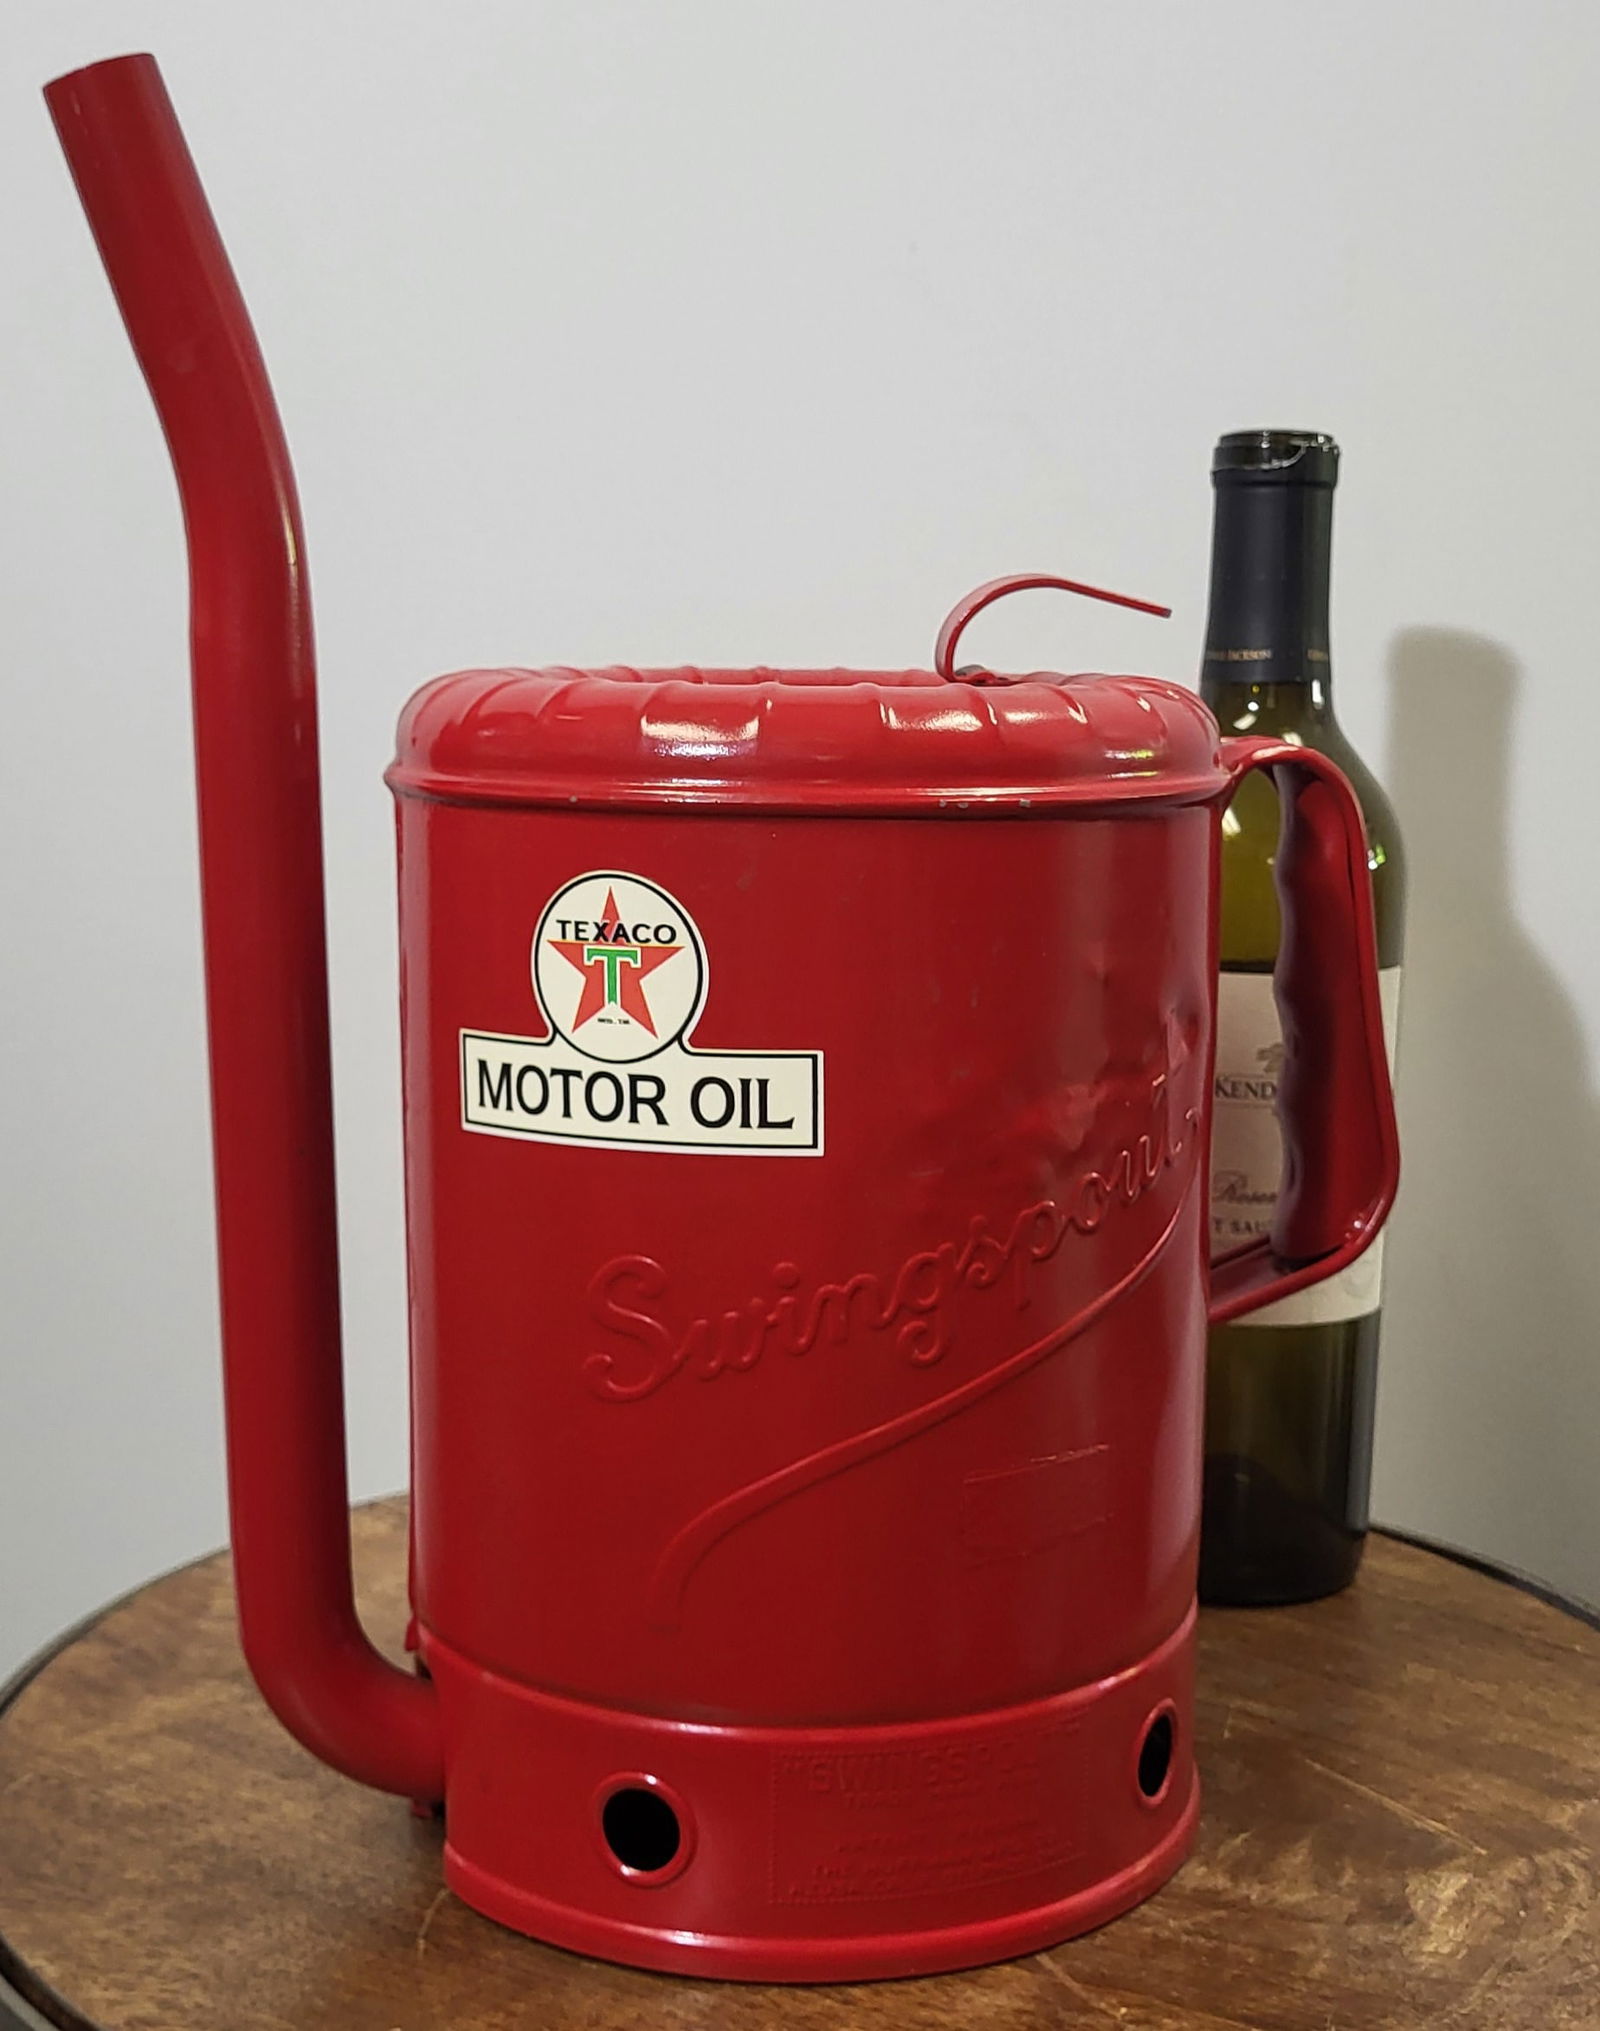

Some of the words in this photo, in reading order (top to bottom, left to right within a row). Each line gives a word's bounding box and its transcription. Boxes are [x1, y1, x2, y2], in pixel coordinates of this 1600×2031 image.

[555, 918, 678, 945] TEXACO
[586, 947, 639, 1006] T
[477, 1058, 670, 1127] MOTOR
[690, 1076, 796, 1130] OIL
[1215, 1077, 1277, 1099] KEND
